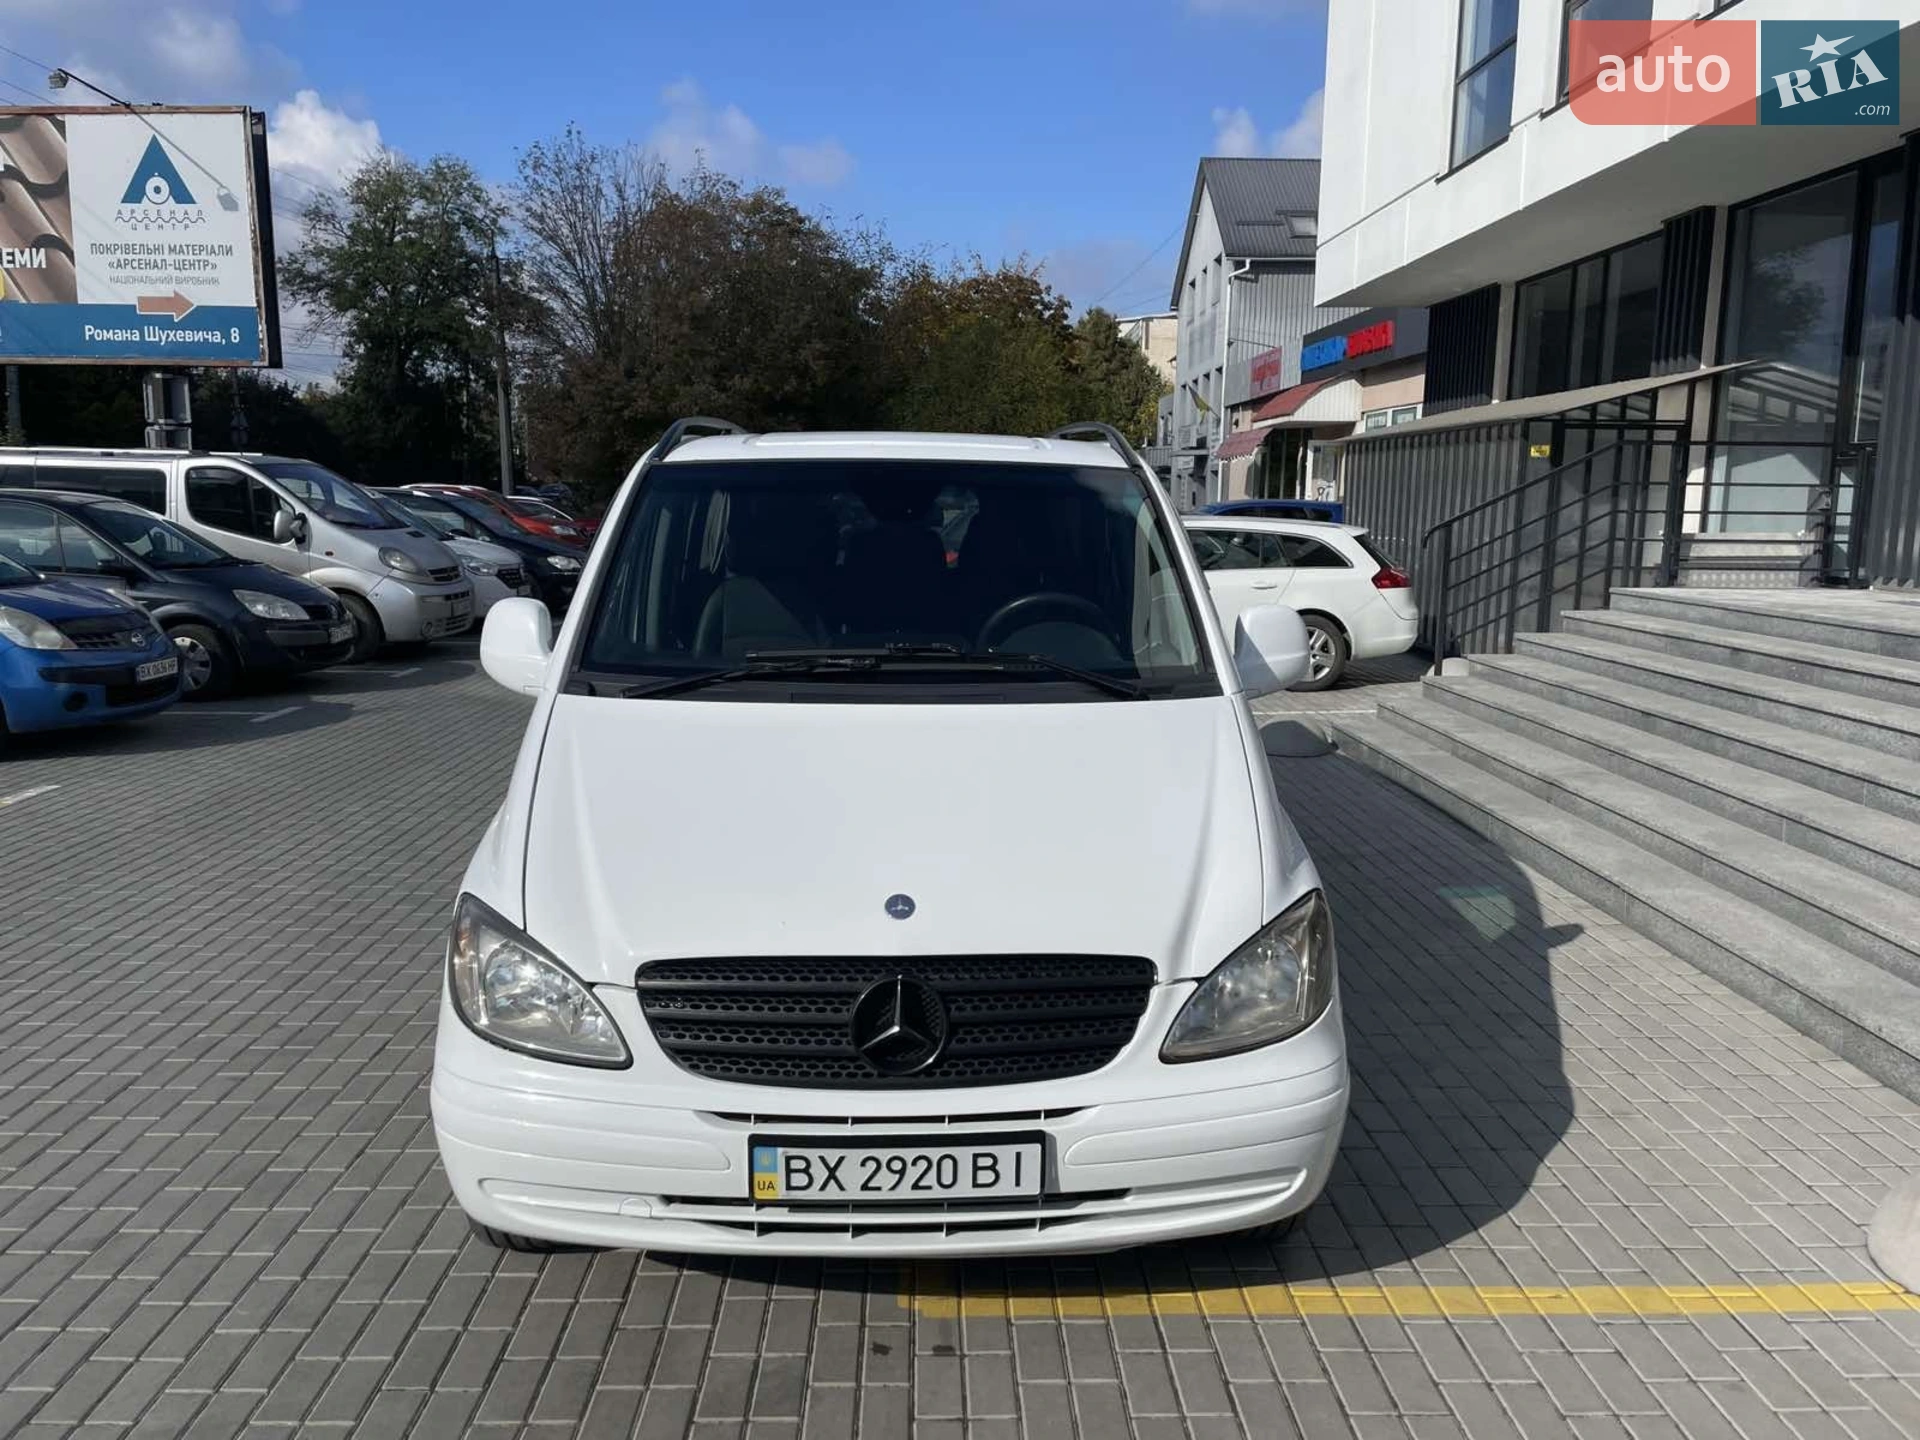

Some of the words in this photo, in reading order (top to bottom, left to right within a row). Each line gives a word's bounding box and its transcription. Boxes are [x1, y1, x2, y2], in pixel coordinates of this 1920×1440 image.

[116, 209, 203, 217] АРСЕНАЛ
[131, 223, 190, 231] ЦЕНТР
[90, 242, 164, 256] ПОКРІВЕЛЬНІ
[168, 244, 233, 256] МАТЕРІАЛИ
[108, 258, 218, 271] «АРСЕНАЛ-ЦЕНТР»
[109, 275, 174, 286] НАЦІОНАЛЬНИЙ
[174, 276, 220, 286] ВИРОБНИК
[84, 324, 140, 342] Романа
[144, 326, 226, 346] Шухевича,
[230, 327, 240, 343] 8
[784, 1154, 847, 1192] BX
[859, 1153, 959, 1192] 2920
[971, 1151, 1022, 1189] BI
[757, 1180, 776, 1192] UA
